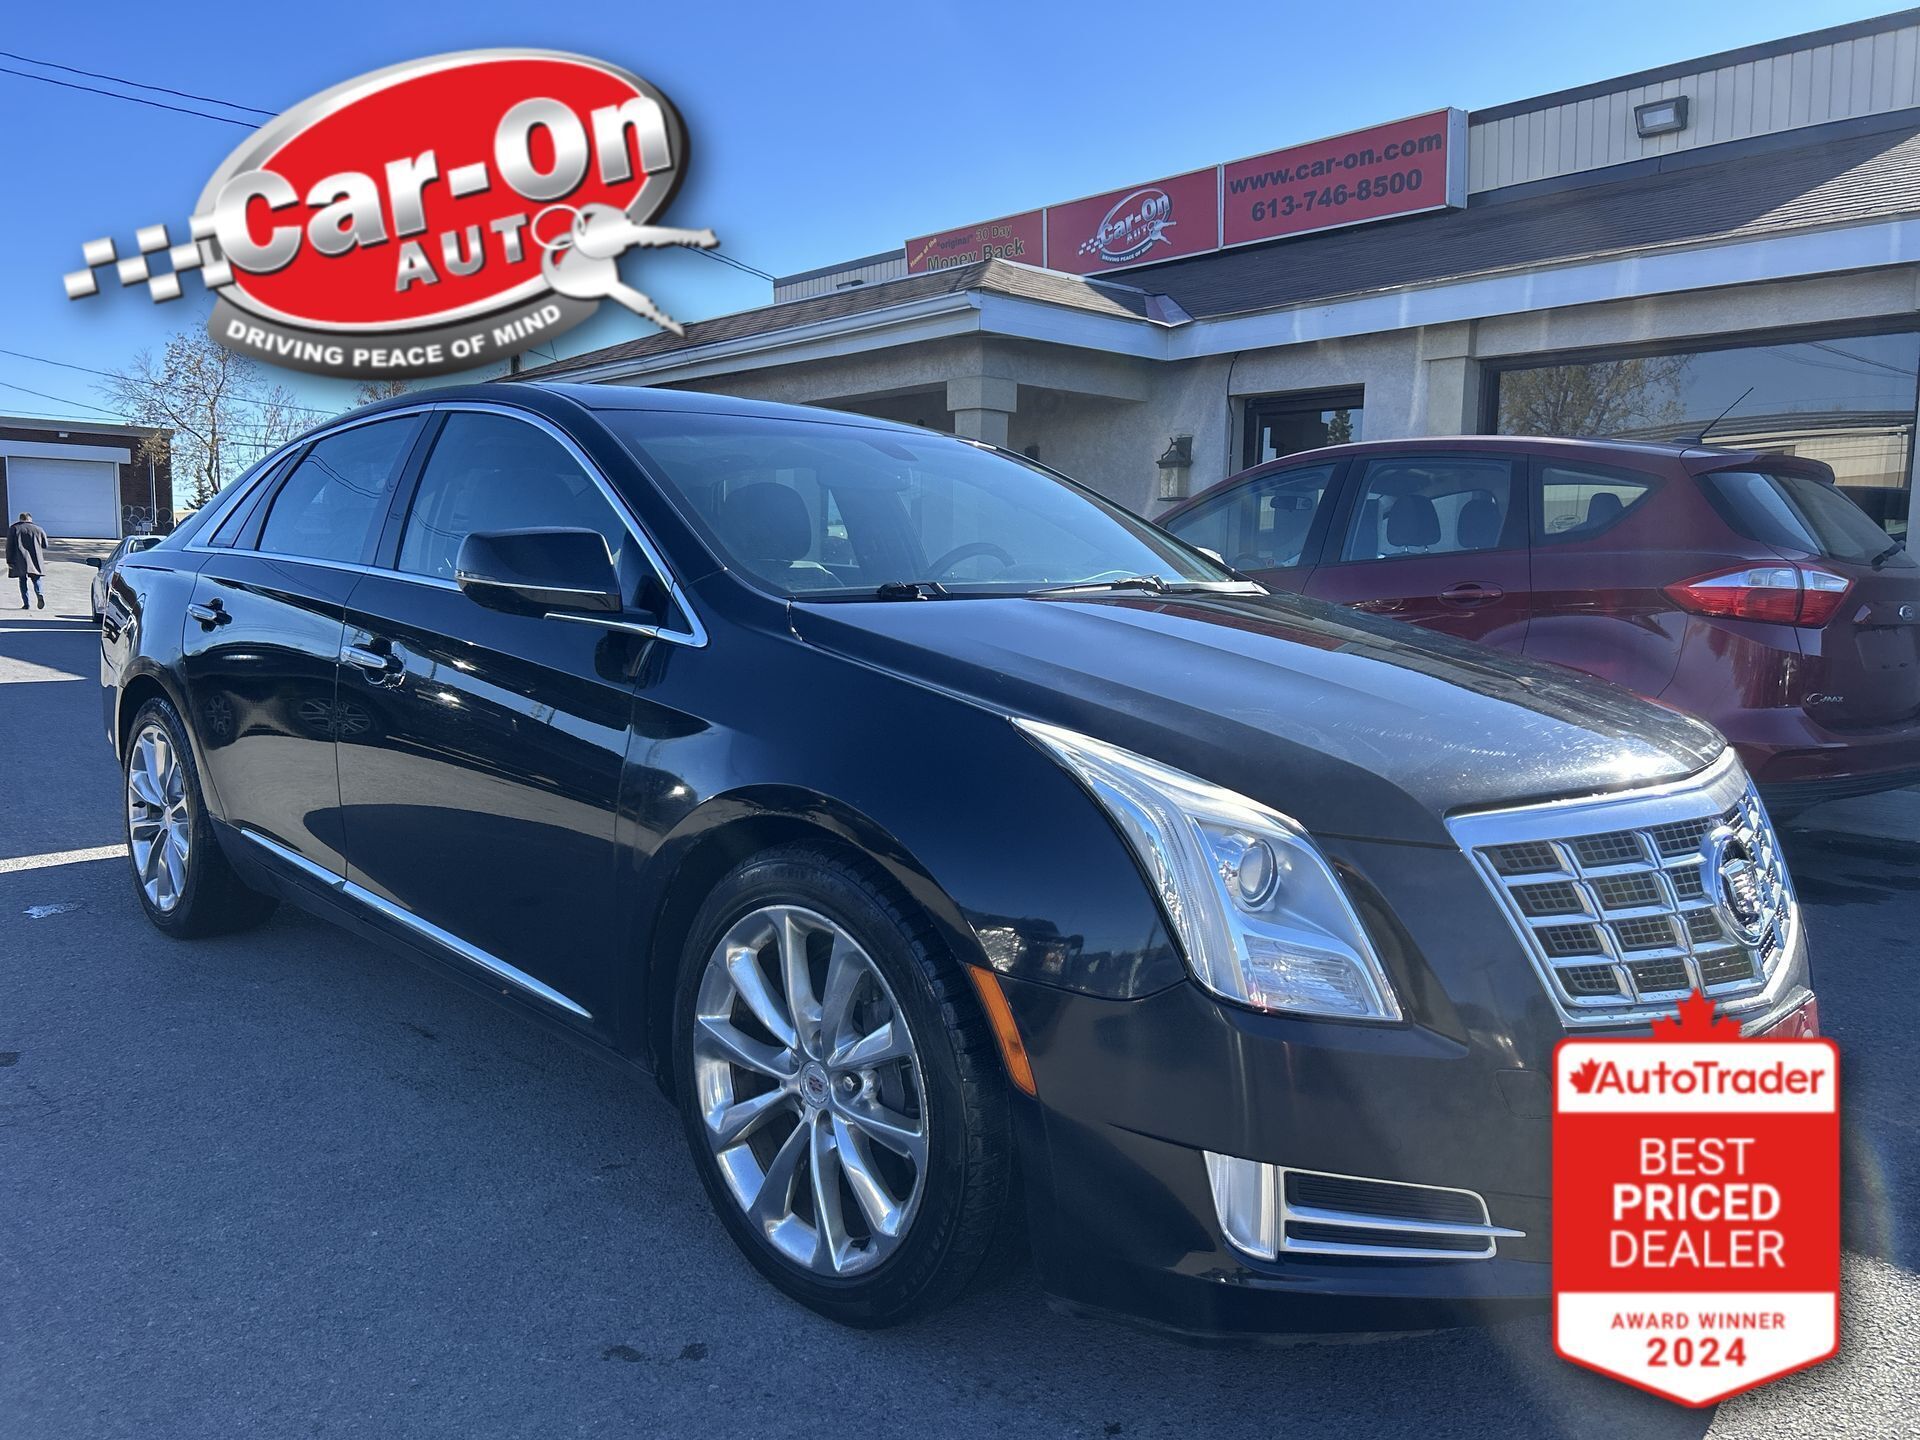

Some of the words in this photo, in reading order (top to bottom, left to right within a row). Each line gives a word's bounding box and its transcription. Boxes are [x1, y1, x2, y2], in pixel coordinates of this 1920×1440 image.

[1230, 133, 1442, 194] www.car-on.com
[1252, 168, 1422, 221] 613-746-8500
[975, 227, 989, 241] 30
[991, 225, 1013, 239] Day
[1101, 195, 1170, 245] Car-On
[981, 237, 1025, 261] Back
